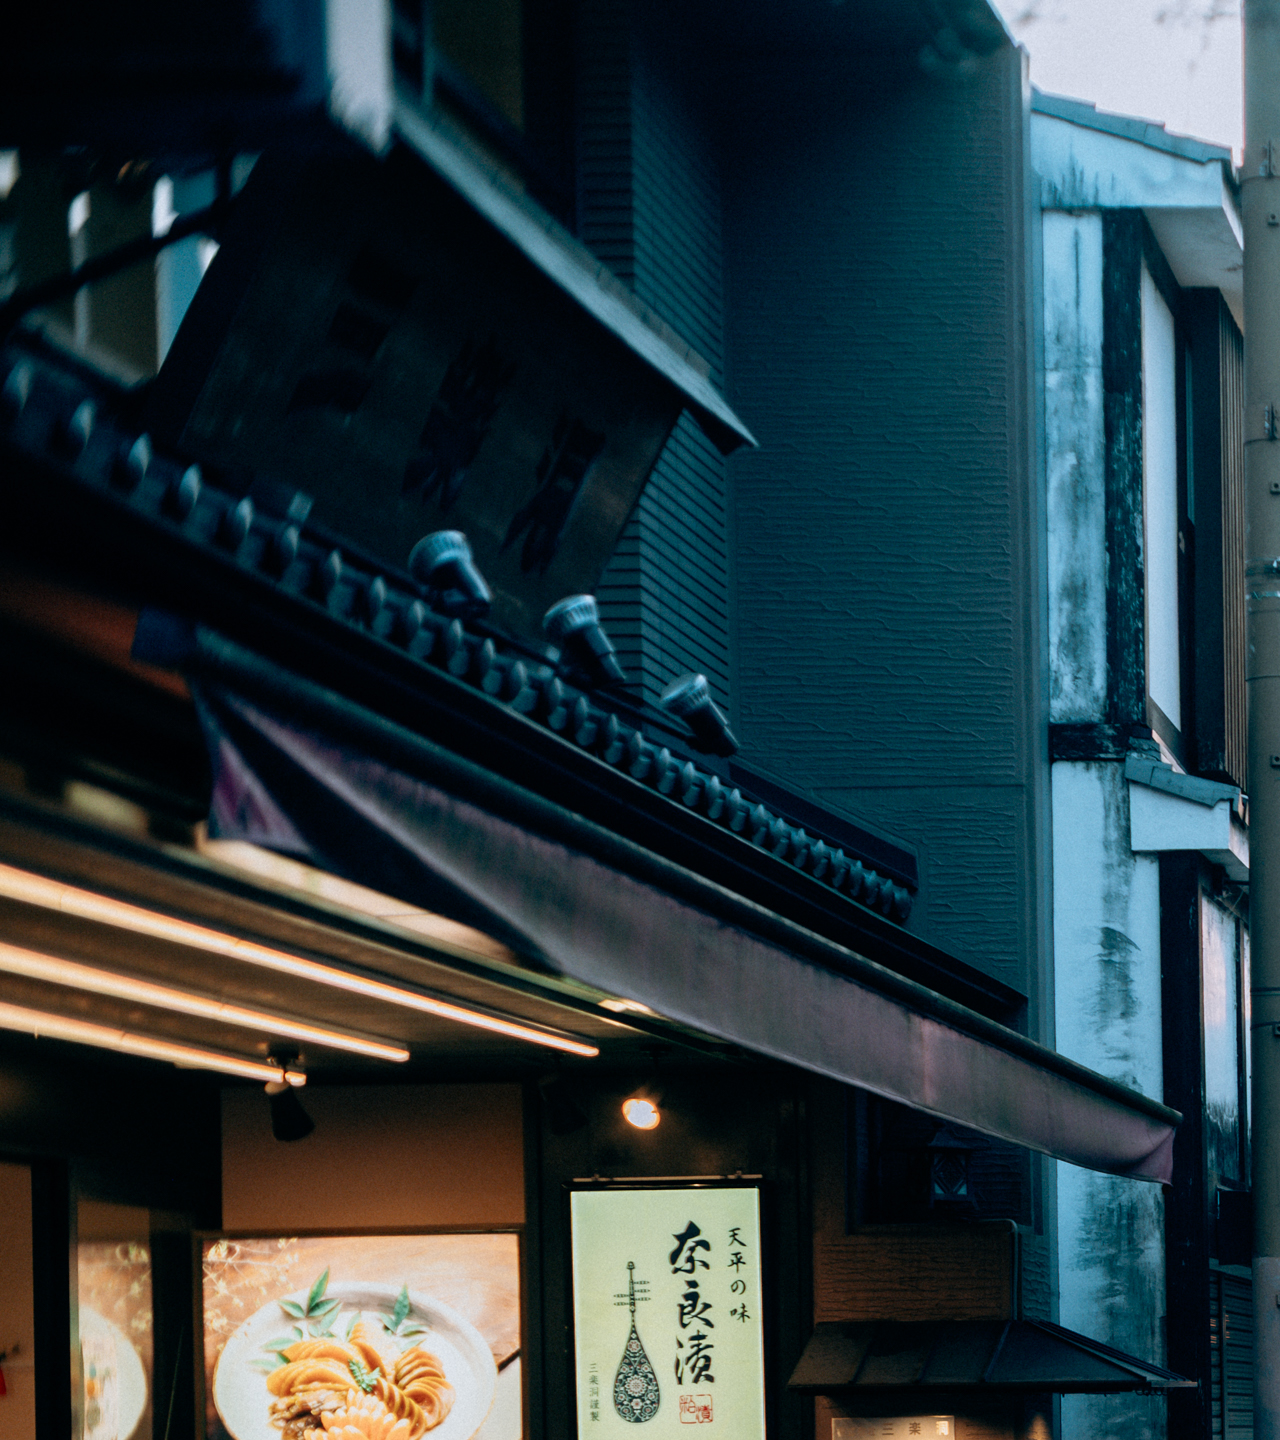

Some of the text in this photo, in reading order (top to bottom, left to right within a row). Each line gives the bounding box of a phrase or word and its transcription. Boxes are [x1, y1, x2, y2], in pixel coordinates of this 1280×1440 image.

[669, 1220, 715, 1385] 奈良漬
[726, 1227, 751, 1323] 天平の味
